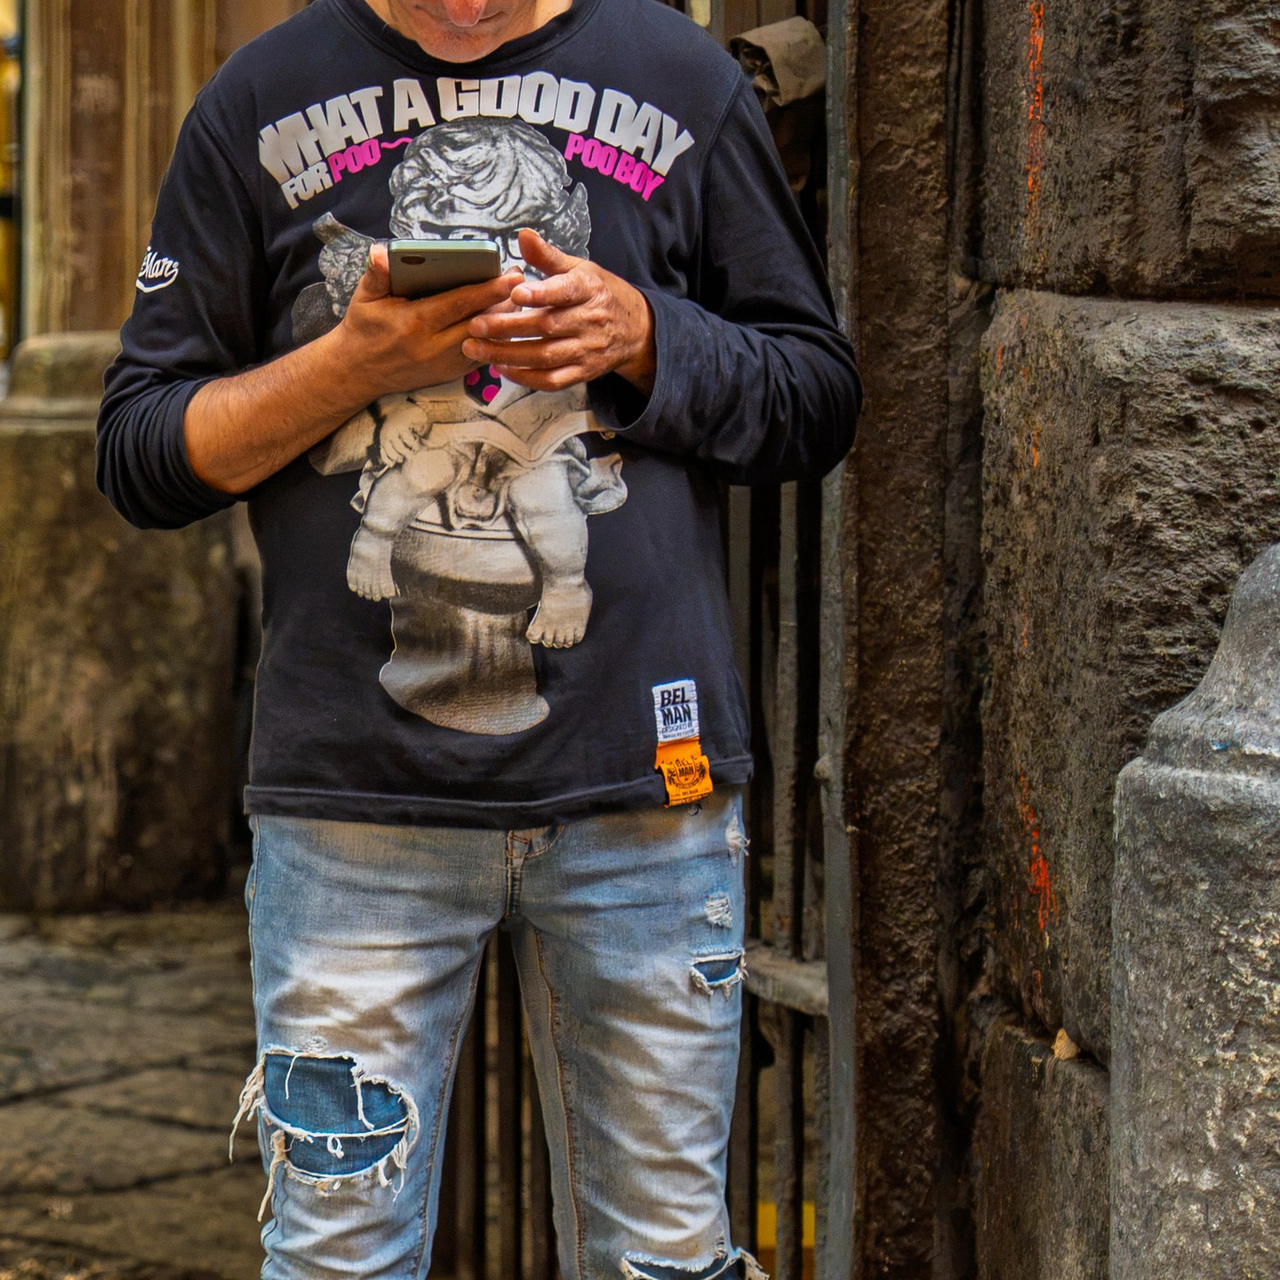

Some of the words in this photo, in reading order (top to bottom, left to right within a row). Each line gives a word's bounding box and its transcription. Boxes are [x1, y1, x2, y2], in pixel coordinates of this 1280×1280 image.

[258, 86, 384, 185] WHAT
[393, 78, 437, 132] A
[436, 71, 597, 134] GOOD
[594, 88, 696, 177] DAY
[280, 162, 334, 210] FOR
[327, 138, 382, 183] POO
[660, 687, 690, 708] BEL
[660, 704, 692, 726] MAN
